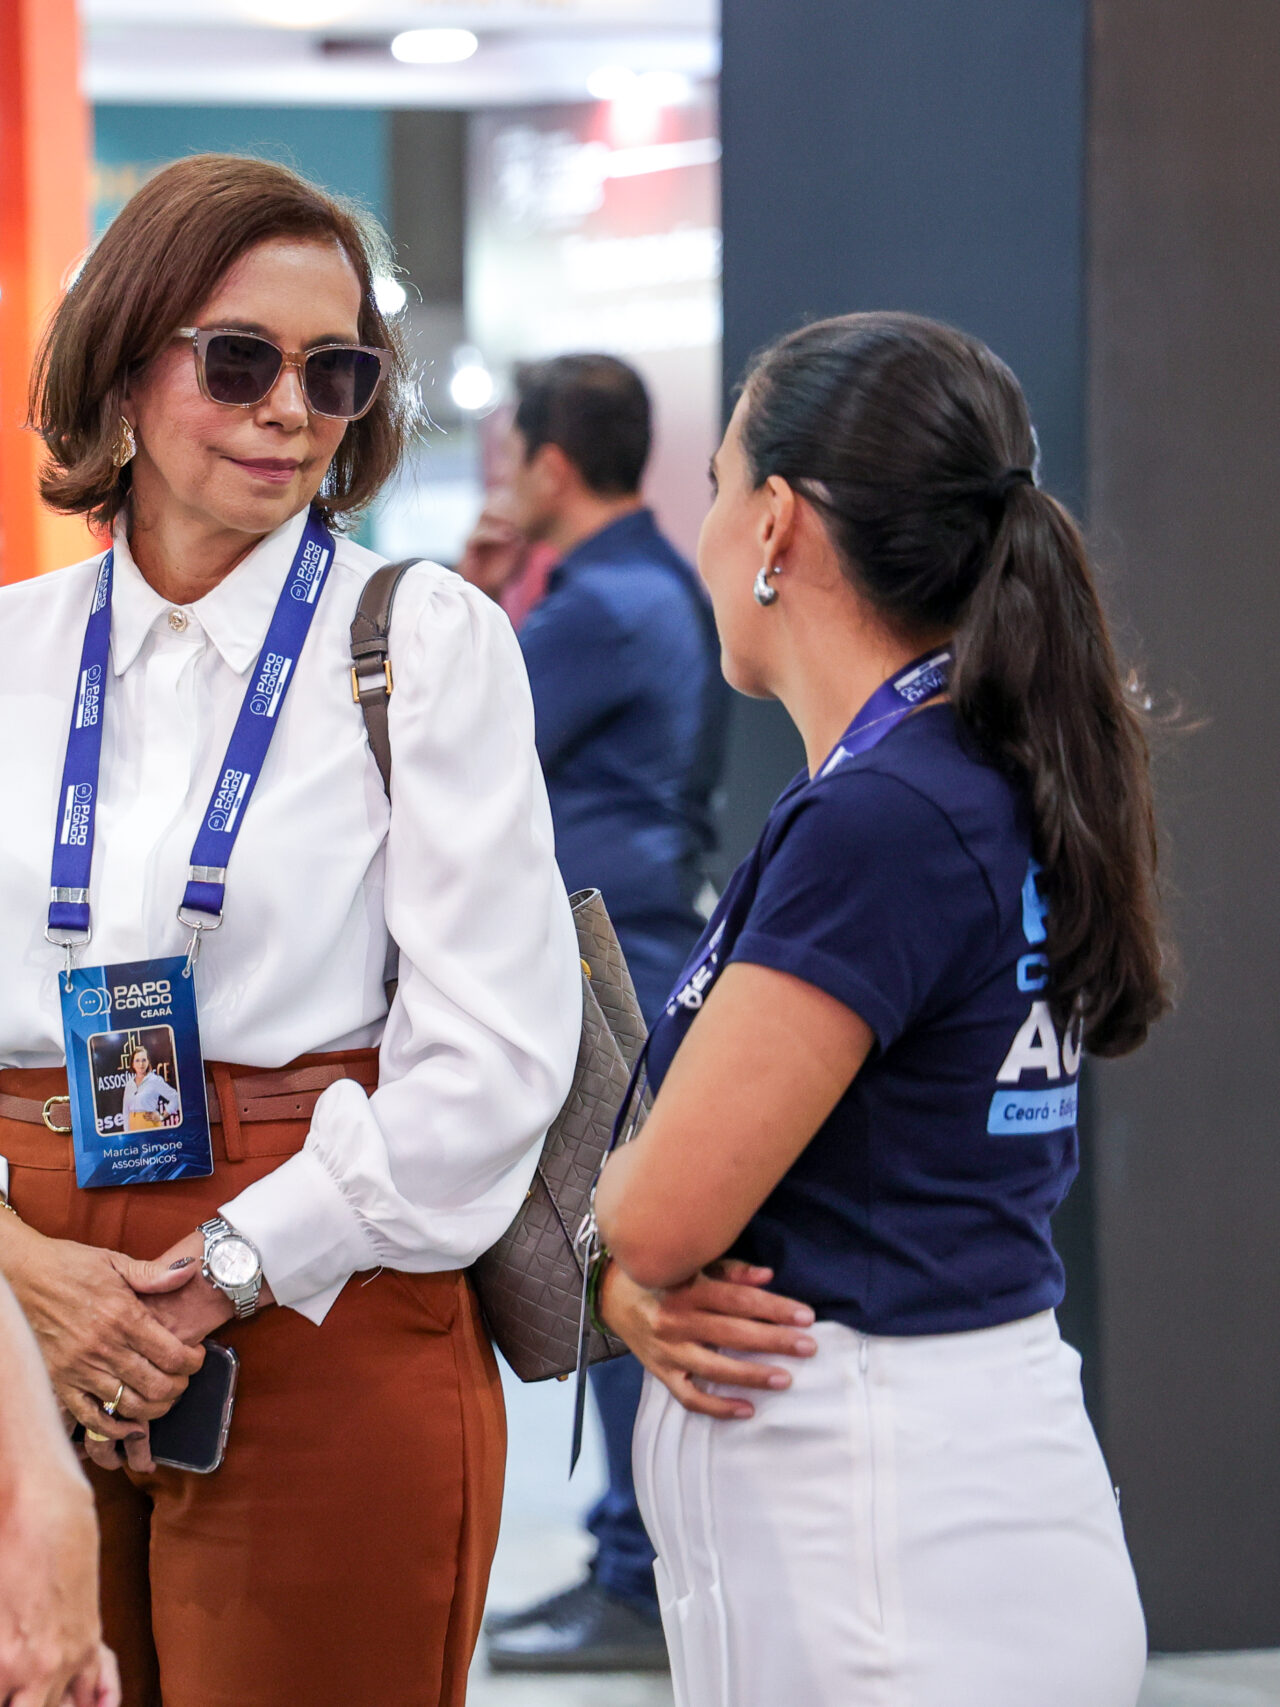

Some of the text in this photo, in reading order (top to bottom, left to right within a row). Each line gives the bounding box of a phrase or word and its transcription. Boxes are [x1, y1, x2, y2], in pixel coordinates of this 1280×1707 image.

[297, 540, 315, 579] PAPO
[305, 545, 322, 582] CONDO
[256, 652, 276, 693] PAPO
[265, 655, 284, 695] CONDO
[83, 687, 93, 727] CONDO
[90, 684, 100, 725] PAPO
[214, 769, 235, 808] PAPO
[223, 771, 243, 810] CONDO
[69, 805, 81, 845] CONDO
[77, 804, 91, 846] PAPO
[113, 980, 171, 999] PAPO
[115, 993, 172, 1010] CONDO
[140, 1005, 173, 1019] CEARÁ
[1004, 1102, 1049, 1120] Ceará
[103, 1141, 183, 1158] Marcia Simone
[111, 1154, 177, 1170] ASSOSÍNDICOS
